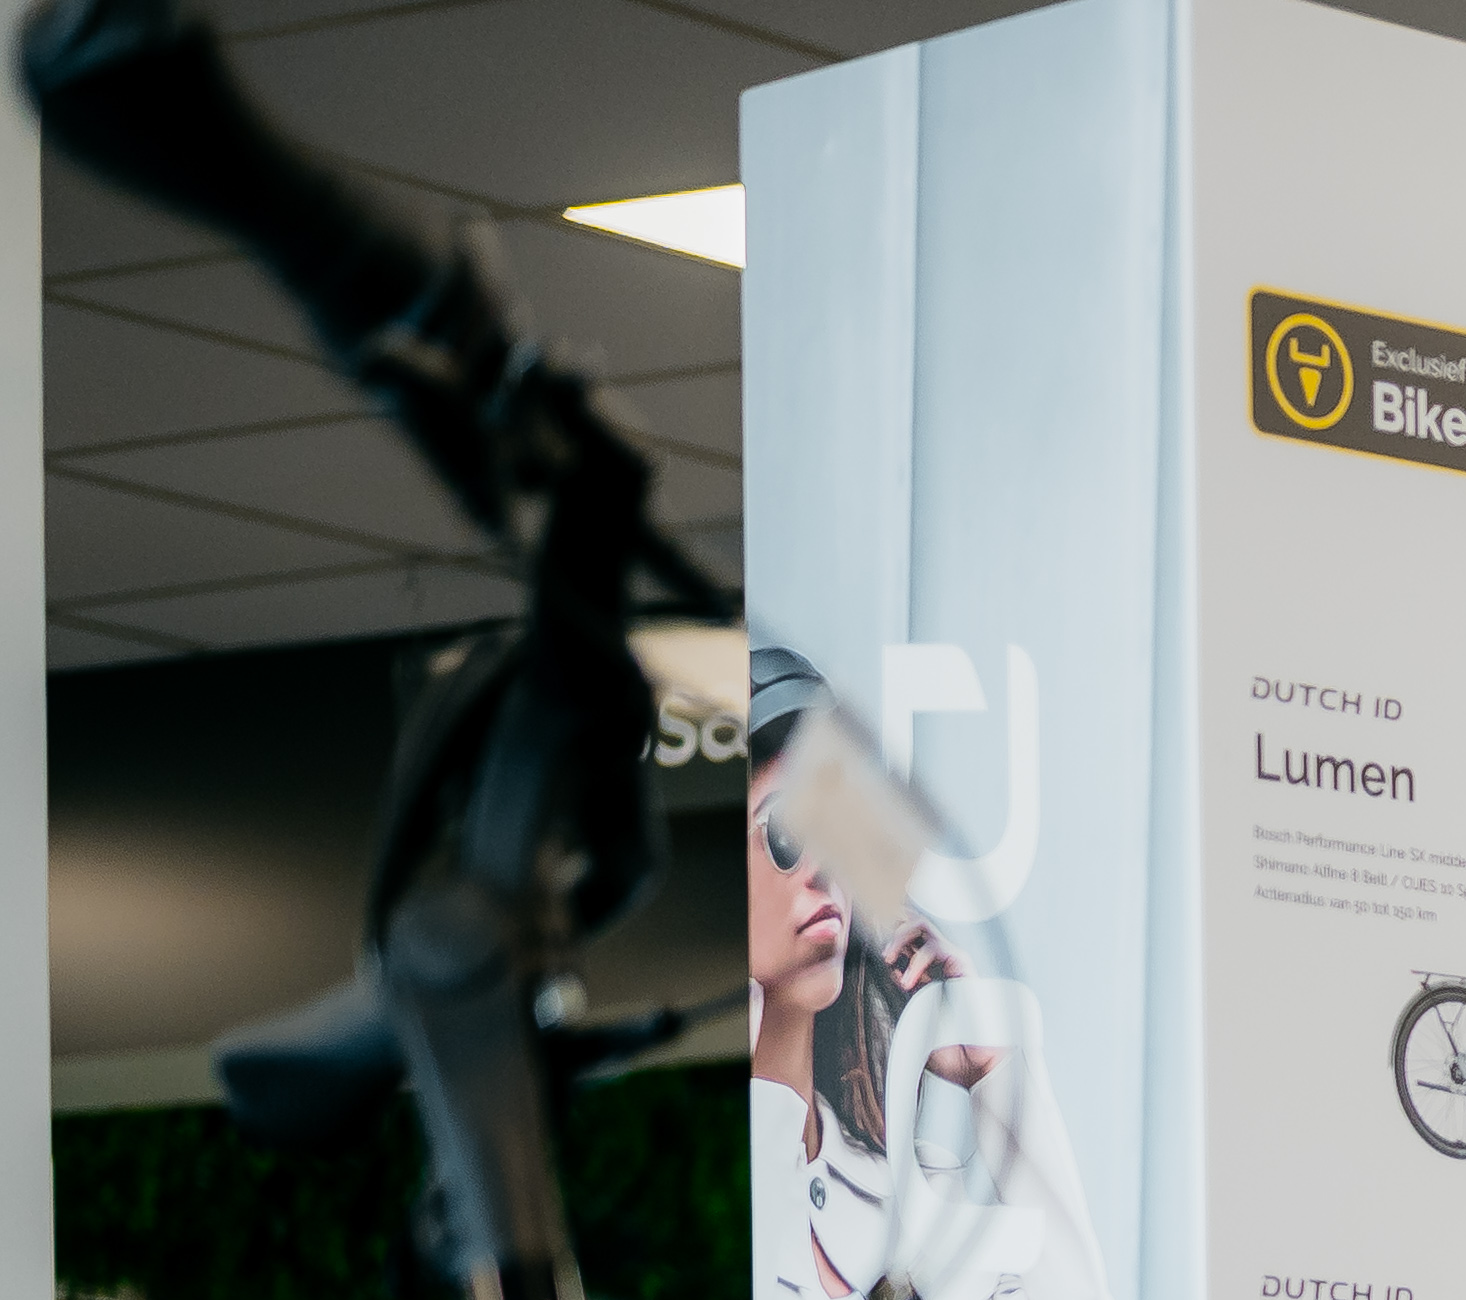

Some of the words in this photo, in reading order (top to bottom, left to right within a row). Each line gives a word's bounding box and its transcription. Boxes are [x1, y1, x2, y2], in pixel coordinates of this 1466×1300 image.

[1253, 676, 1361, 714] DUTCH
[1375, 697, 1402, 721] ID
[1256, 733, 1414, 802] Lumen
